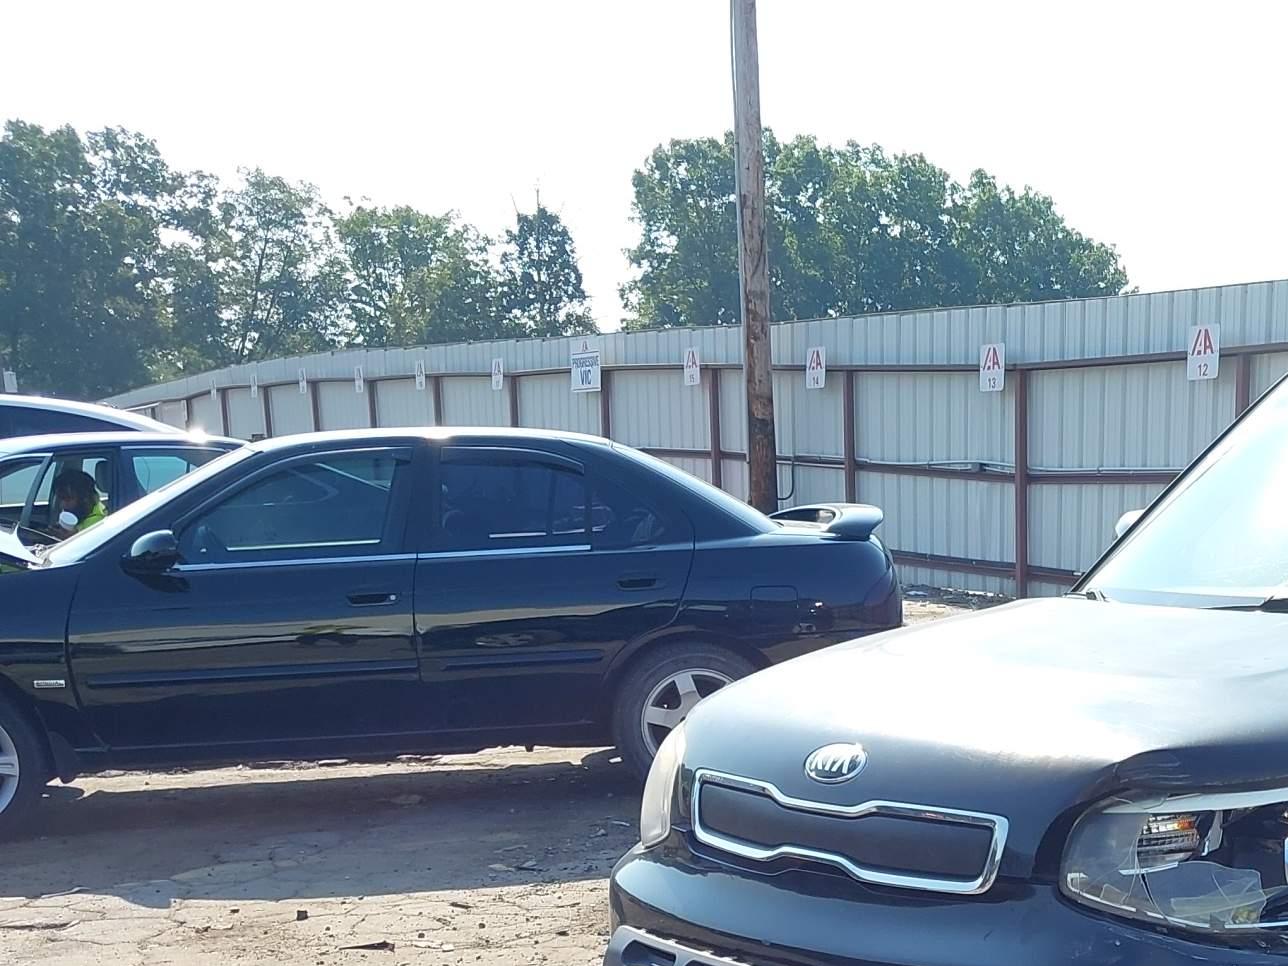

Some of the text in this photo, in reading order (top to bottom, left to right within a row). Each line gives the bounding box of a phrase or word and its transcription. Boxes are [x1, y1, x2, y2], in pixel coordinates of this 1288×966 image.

[571, 355, 599, 369] PROGRESSIVE
[1197, 362, 1209, 377] 12
[579, 368, 592, 386] VIC
[812, 375, 820, 387] 14
[987, 377, 997, 390] 13
